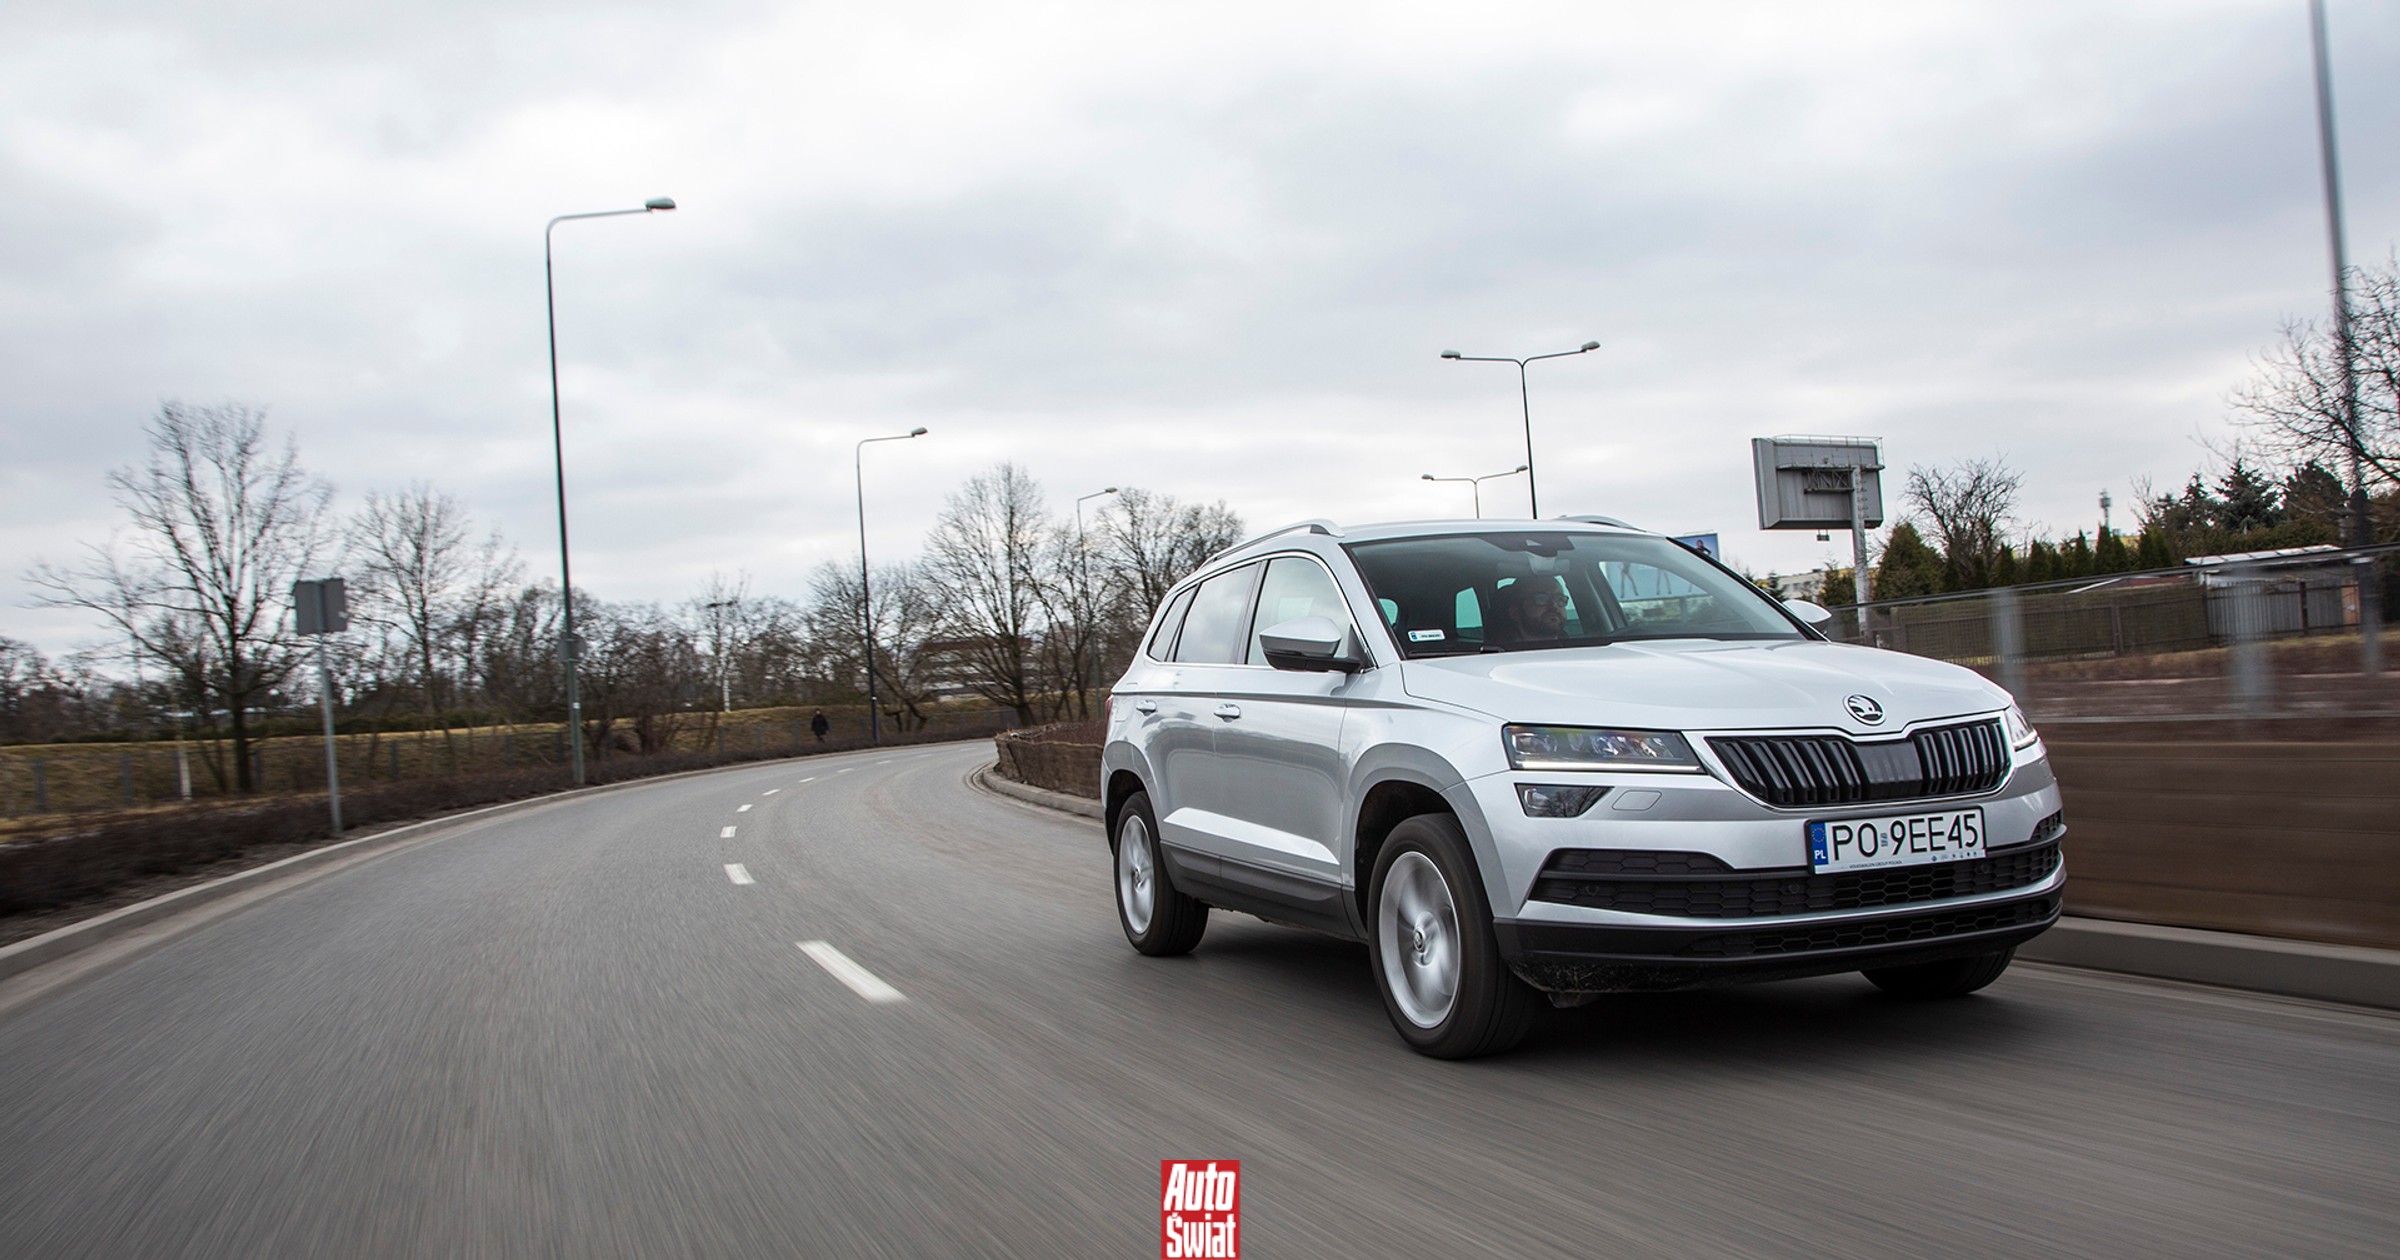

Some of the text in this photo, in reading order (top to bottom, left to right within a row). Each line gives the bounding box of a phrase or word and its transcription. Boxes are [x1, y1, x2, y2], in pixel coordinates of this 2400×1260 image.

[1832, 814, 1978, 861] PO 9EE45
[1814, 850, 1826, 860] PL
